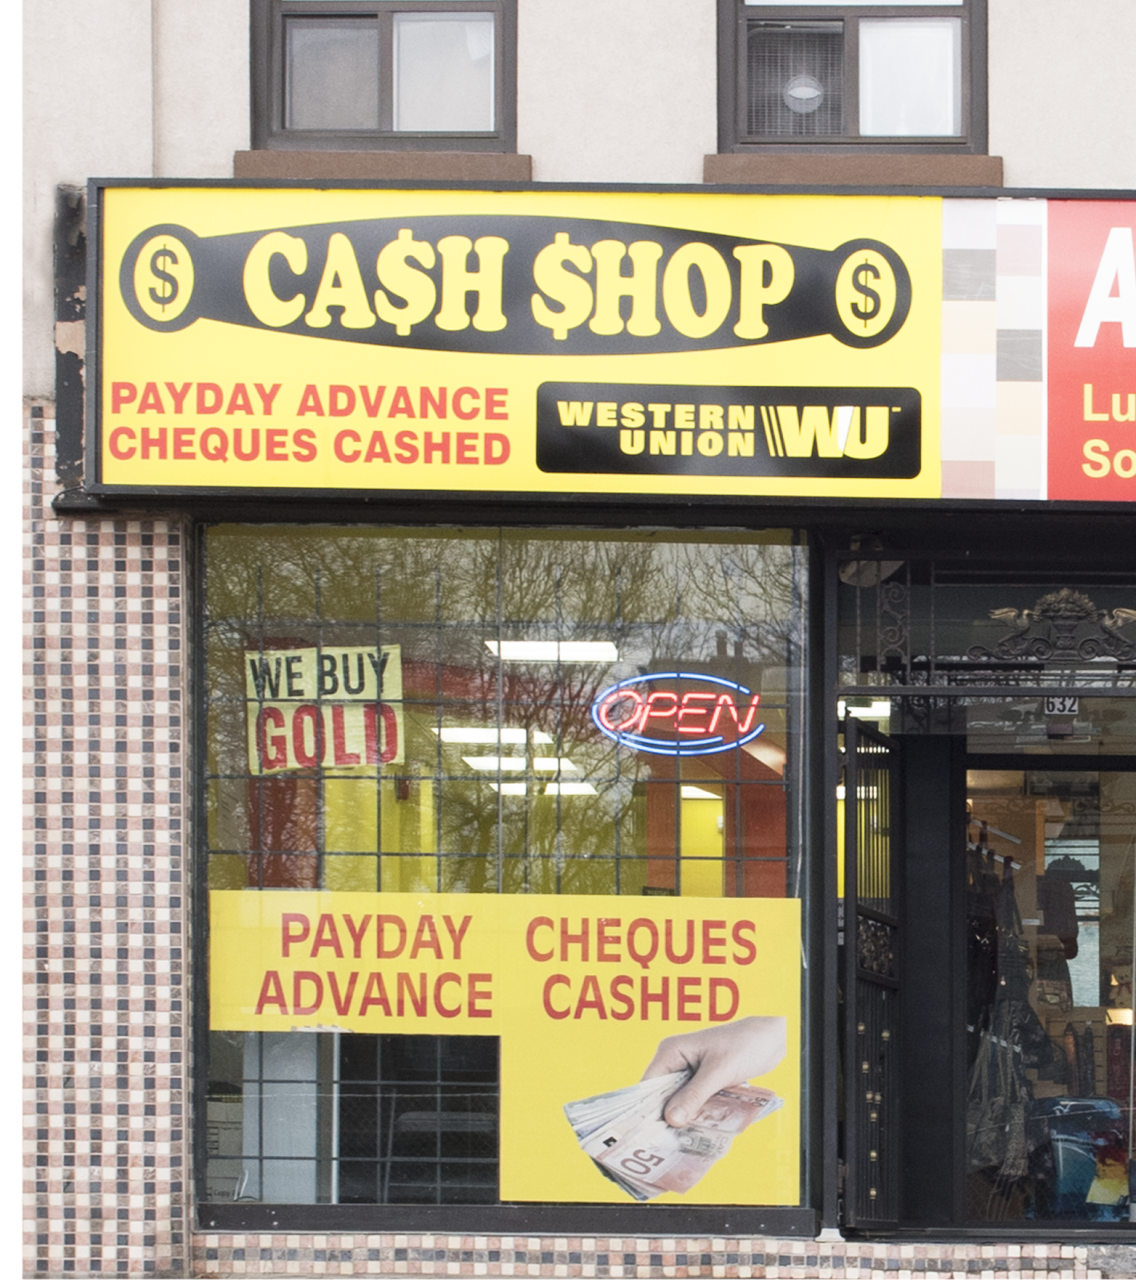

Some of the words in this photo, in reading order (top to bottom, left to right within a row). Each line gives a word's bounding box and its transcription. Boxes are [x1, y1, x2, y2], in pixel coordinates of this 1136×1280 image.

[243, 228, 510, 336] CA$H
[531, 231, 795, 340] $HOP
[111, 381, 282, 416] PAYDAY
[297, 385, 510, 420] ADVANCE
[557, 400, 755, 430] WESTERN
[109, 427, 317, 463] CHEQUES
[333, 430, 511, 466] CASHED
[619, 430, 755, 458] UNION
[249, 655, 304, 699] WE
[318, 651, 390, 696] BUY
[599, 690, 761, 734] OPEN
[1046, 695, 1078, 713] 632
[256, 703, 400, 772] GOLD
[281, 912, 473, 961] PAYDAY
[525, 916, 758, 969] CHEQUES
[254, 970, 494, 1019] ADVANCE
[542, 974, 740, 1022] CASHED
[620, 1148, 665, 1176] 50
